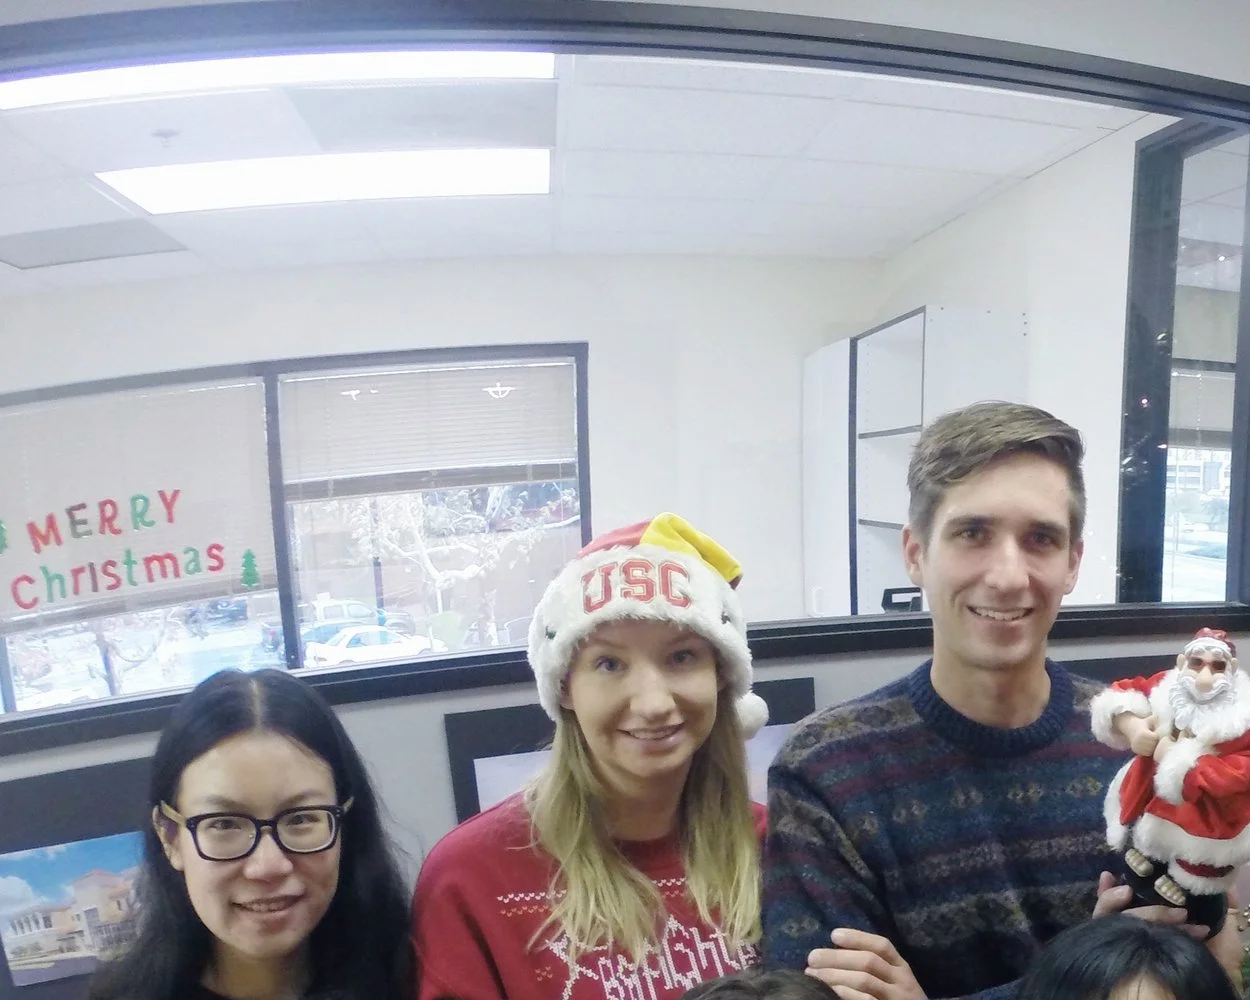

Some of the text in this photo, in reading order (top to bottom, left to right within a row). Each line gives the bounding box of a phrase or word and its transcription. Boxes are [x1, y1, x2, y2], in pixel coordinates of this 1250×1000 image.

[26, 488, 181, 554] MERRY
[10, 543, 225, 610] Christmas
[581, 558, 694, 615] USC
